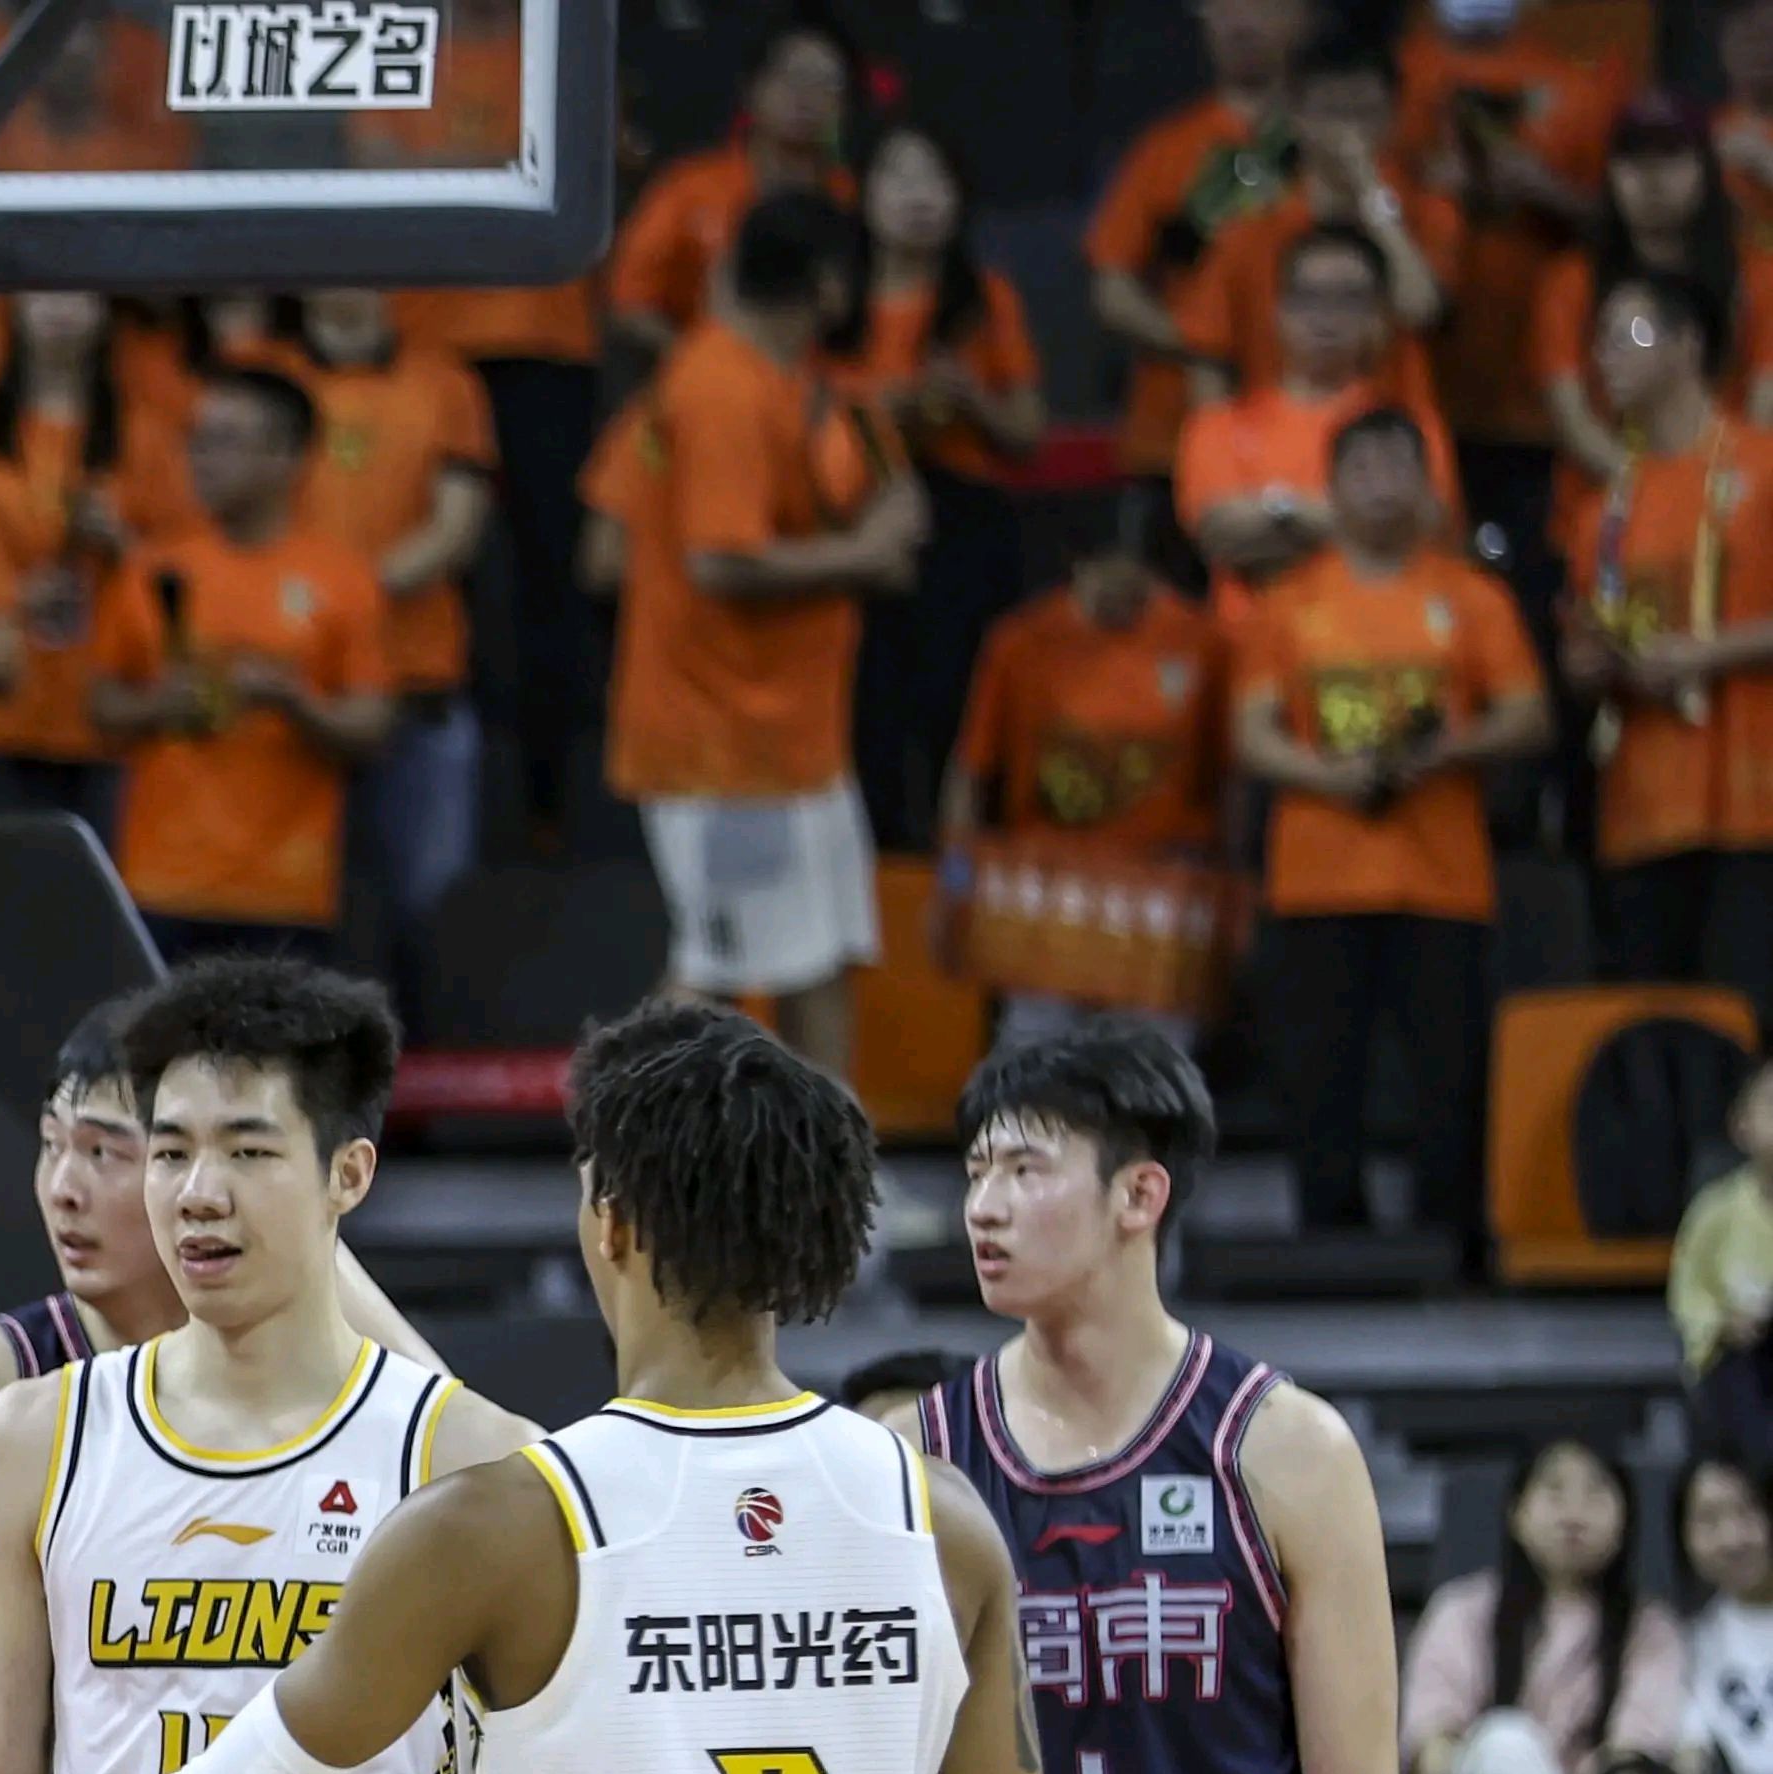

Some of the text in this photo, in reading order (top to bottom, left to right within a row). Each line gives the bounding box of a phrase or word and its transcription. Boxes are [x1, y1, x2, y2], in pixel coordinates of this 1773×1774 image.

[175, 8, 431, 100] 以城之名
[316, 1538, 349, 1555] CGB
[624, 1606, 920, 1694] 东阳光药
